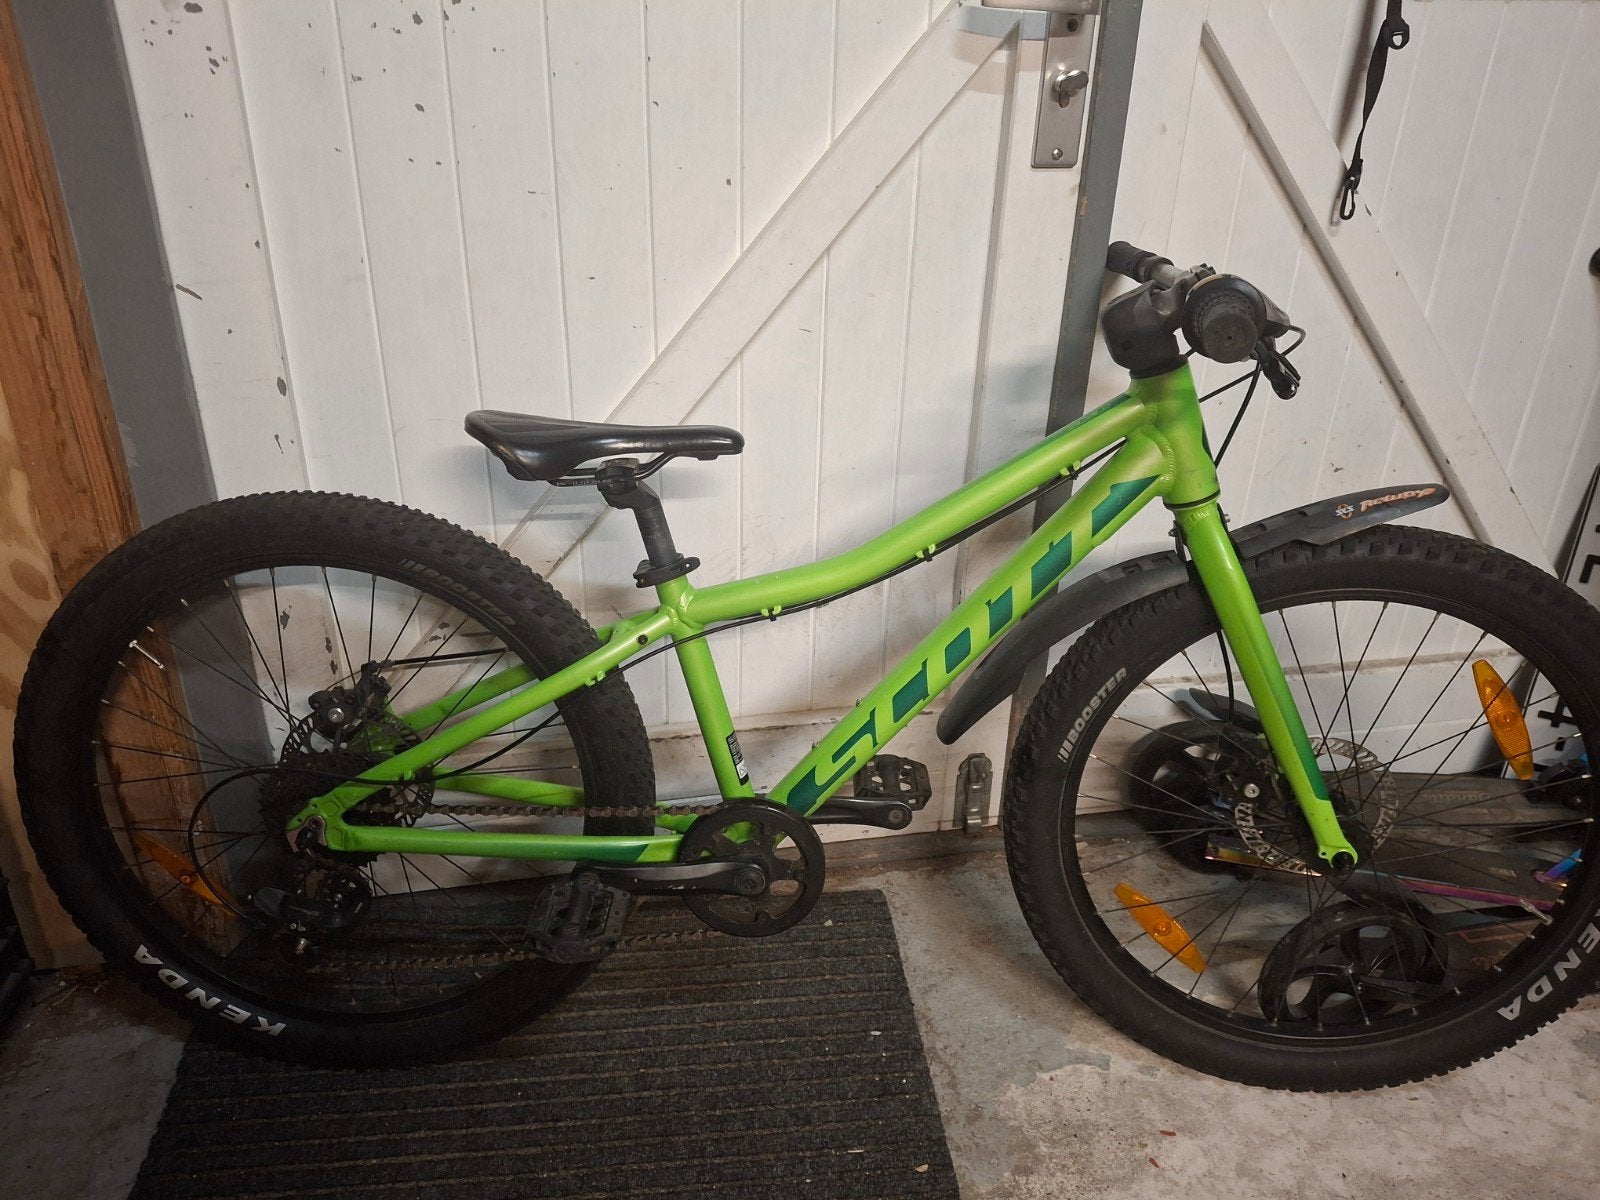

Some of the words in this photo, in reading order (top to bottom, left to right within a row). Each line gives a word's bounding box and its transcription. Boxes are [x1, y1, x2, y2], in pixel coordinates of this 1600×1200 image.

[1065, 666, 1128, 746] BOOSTER
[133, 944, 287, 1036] KENDA
[1496, 908, 1600, 1021] ENDA
